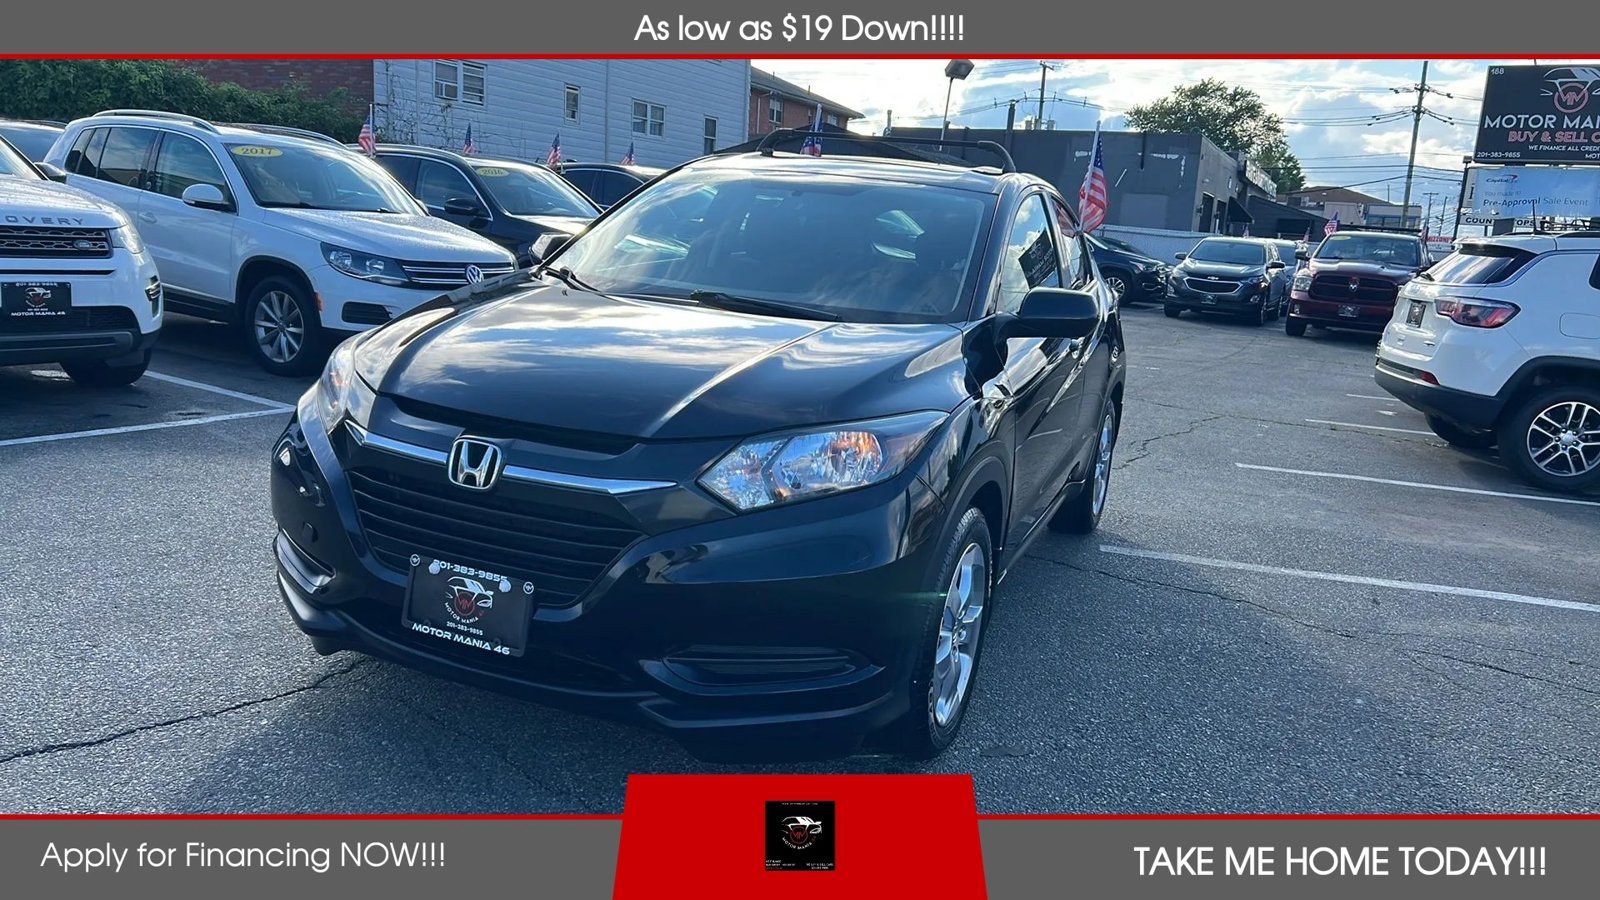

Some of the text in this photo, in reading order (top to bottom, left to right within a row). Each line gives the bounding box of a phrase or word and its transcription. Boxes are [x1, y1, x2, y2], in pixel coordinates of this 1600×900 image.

[1484, 114, 1557, 129] MOTOR
[1508, 131, 1538, 142] BUY
[1541, 131, 1551, 142] &
[1555, 131, 1588, 143] SELL
[1483, 197, 1588, 208] Pre-Approval Sale Event
[445, 602, 460, 621] MOTOR
[412, 622, 511, 656] MOTOR MANIA 46
